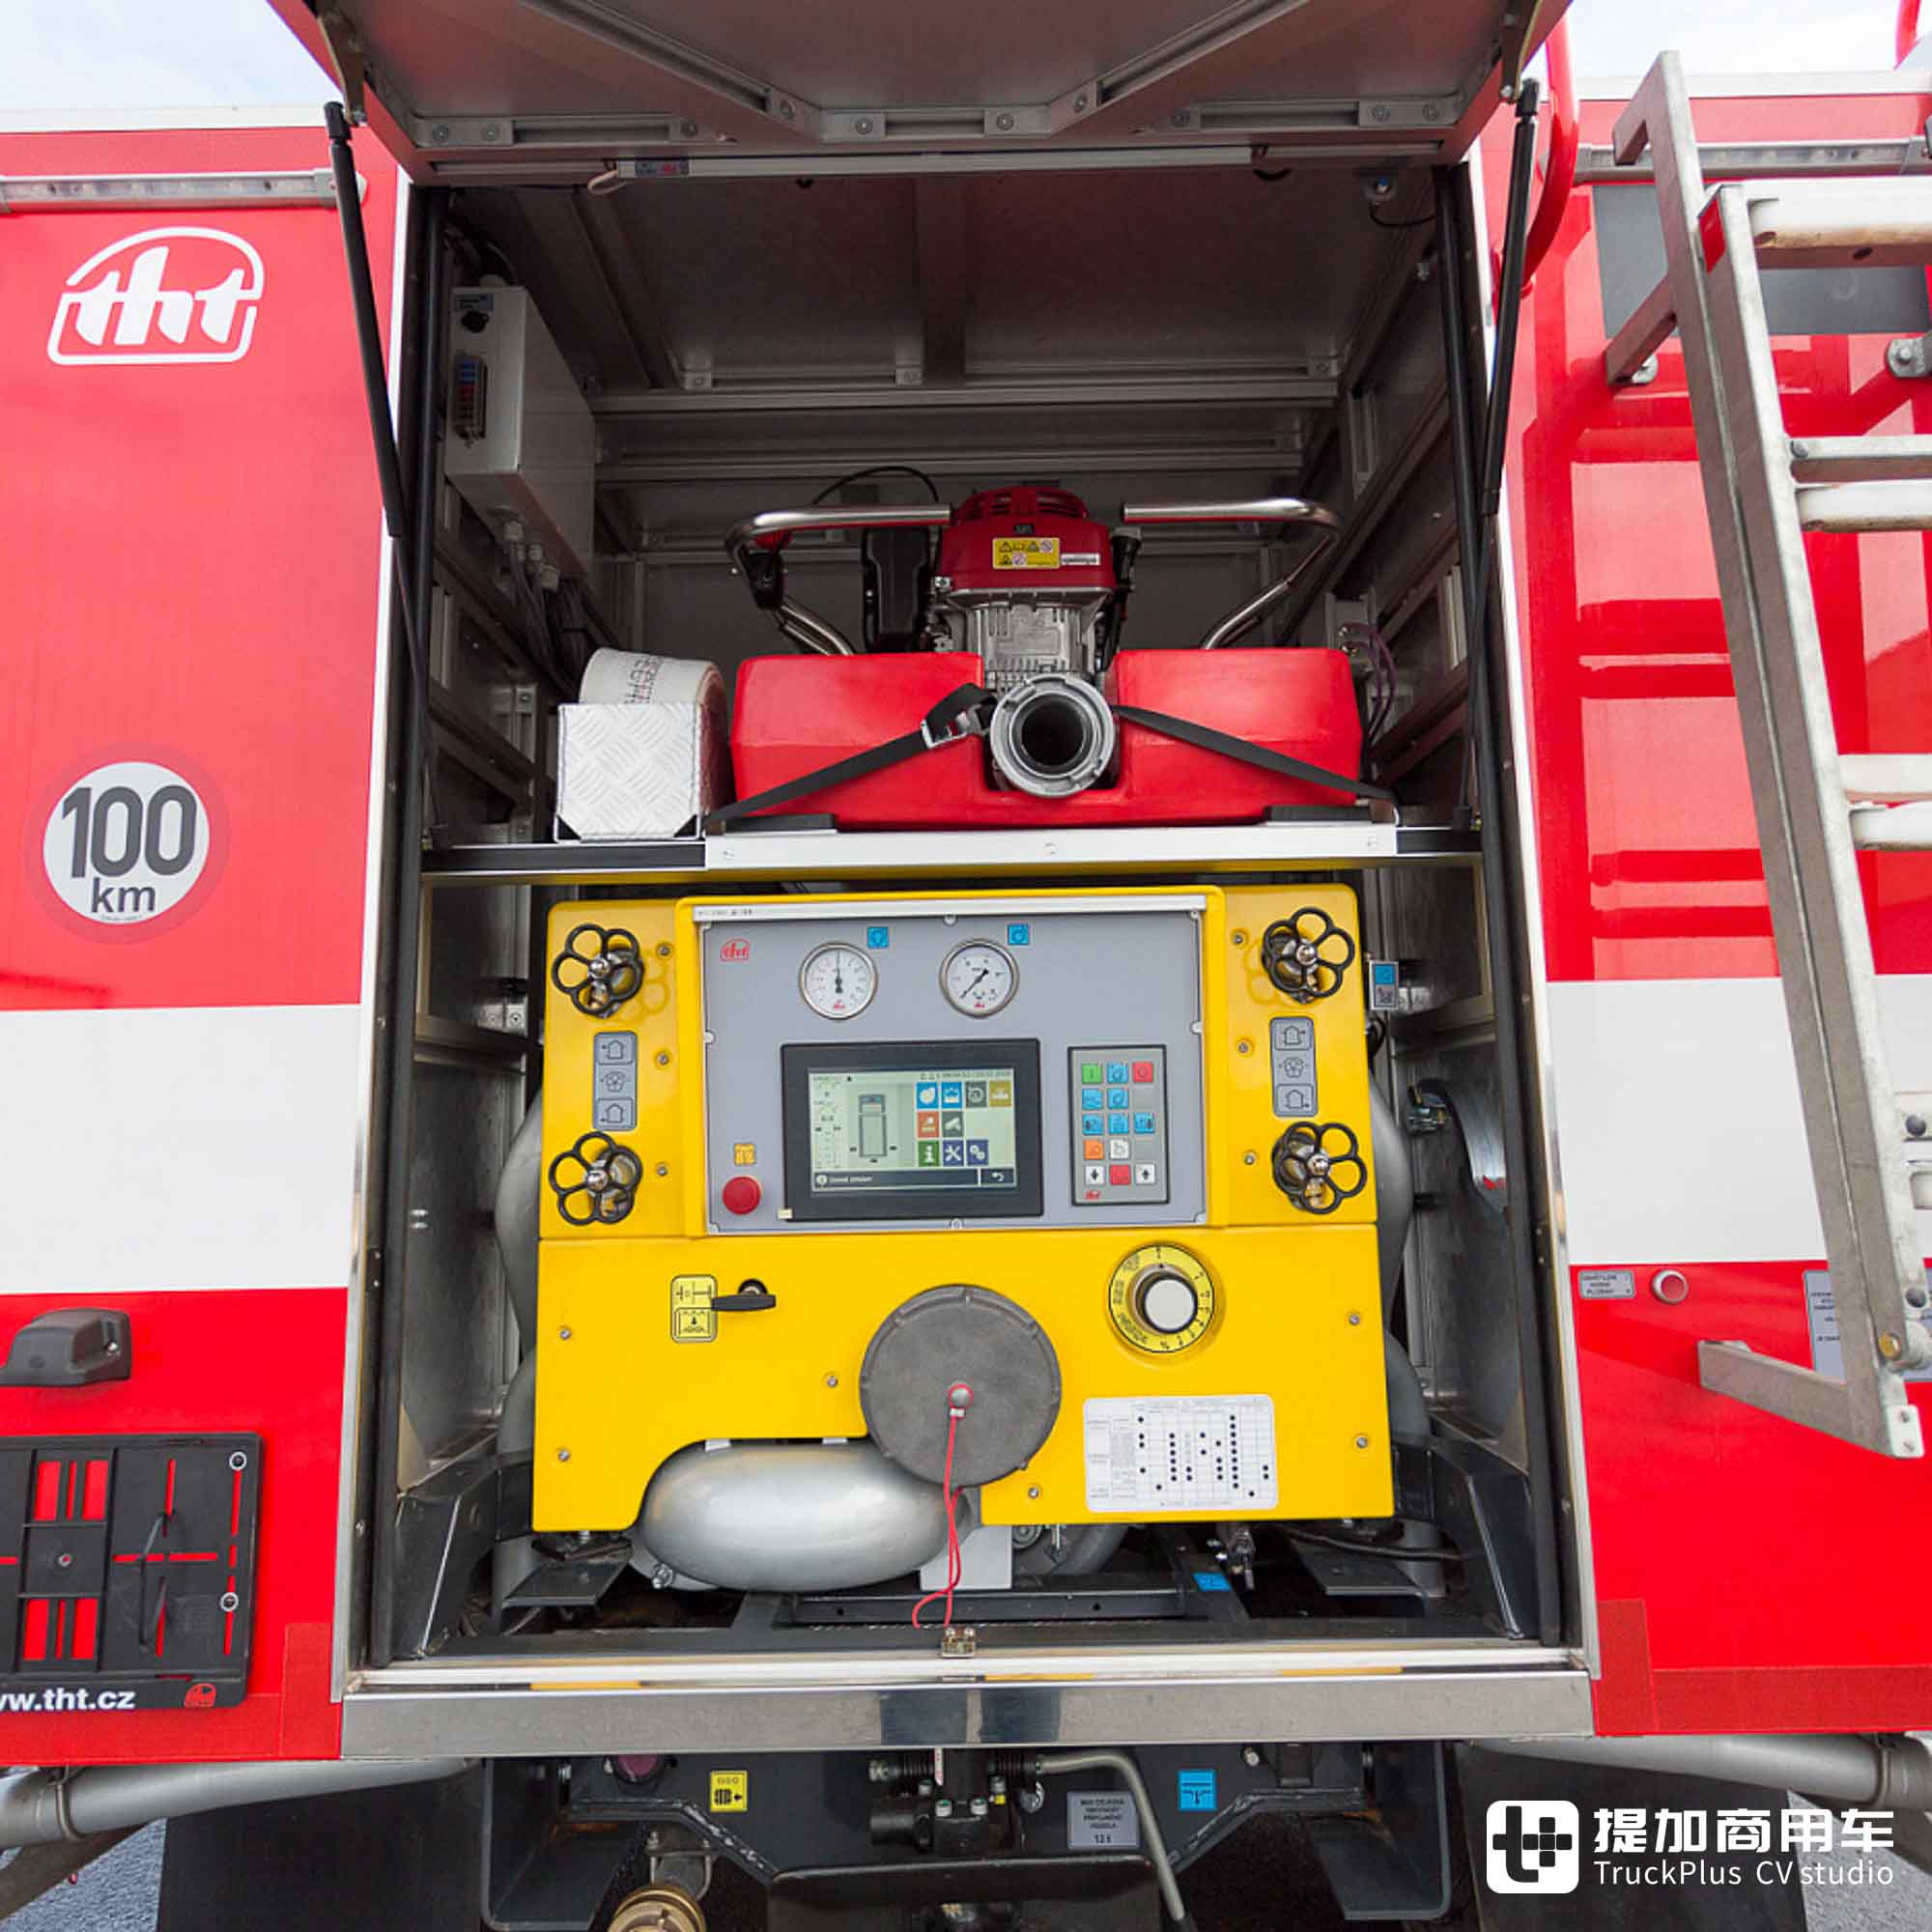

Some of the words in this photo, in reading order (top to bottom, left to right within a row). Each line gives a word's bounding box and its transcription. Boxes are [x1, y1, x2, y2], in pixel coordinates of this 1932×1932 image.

[60, 242, 263, 347] tht
[62, 784, 197, 877] 100
[92, 877, 156, 913] km
